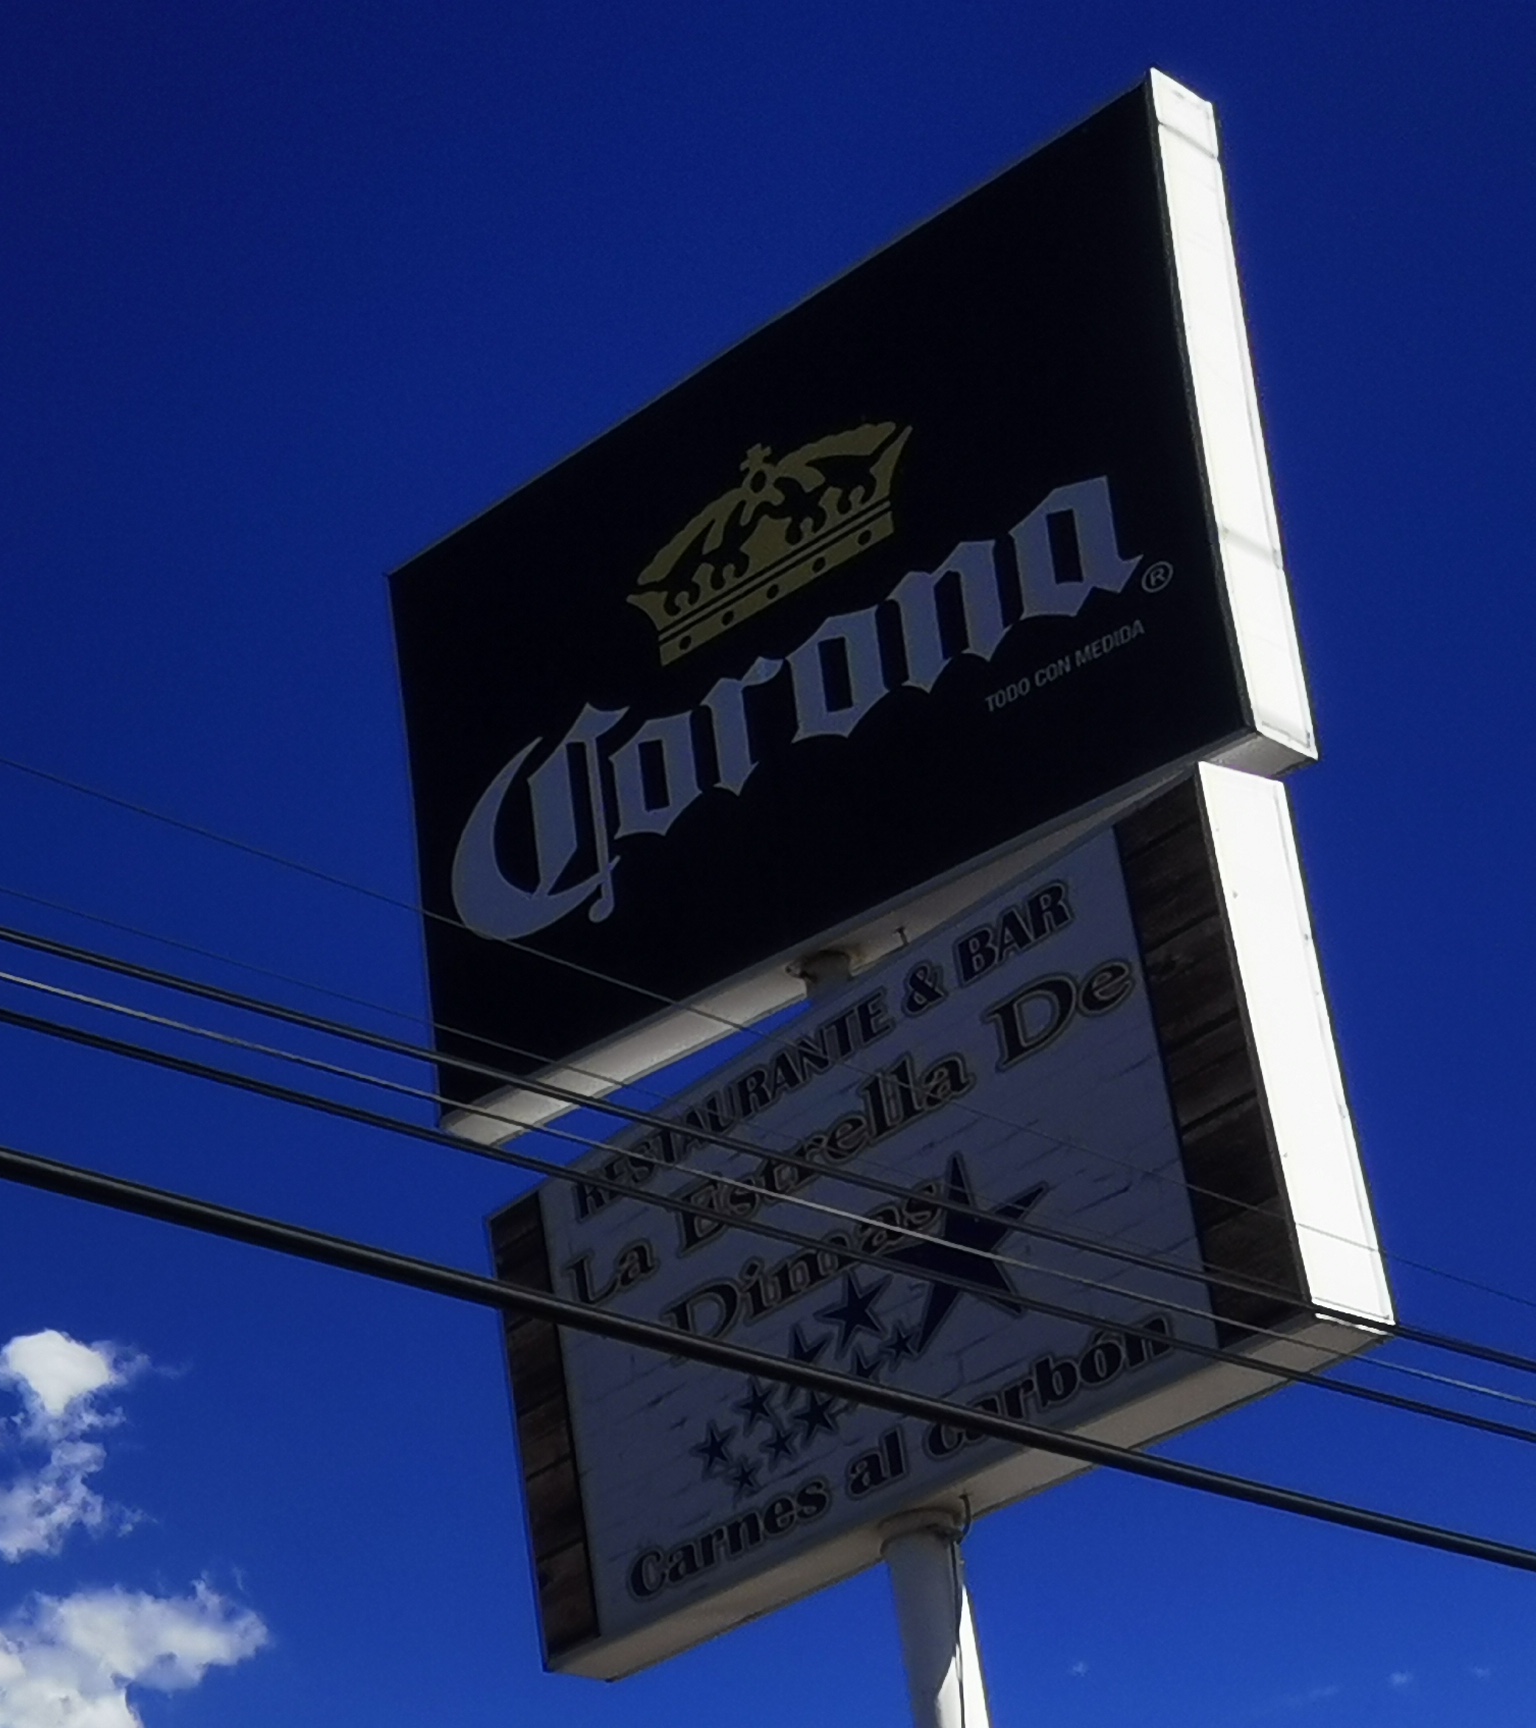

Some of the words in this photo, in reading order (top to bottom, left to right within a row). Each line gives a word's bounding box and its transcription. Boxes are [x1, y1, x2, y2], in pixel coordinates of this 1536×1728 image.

[451, 475, 1143, 942] Corona
[985, 677, 1031, 712] TODO
[1034, 655, 1072, 688] CON
[1075, 618, 1146, 668] MEDIDA
[565, 1239, 659, 1306] La
[673, 1051, 975, 1257] Estrella
[983, 959, 1134, 1071] De
[573, 988, 894, 1220] RESTAURANTE
[903, 961, 948, 1017] &
[954, 880, 1075, 988] BAR
[661, 1177, 946, 1364] Dimas
[628, 1476, 830, 1601] Carnes
[848, 1424, 907, 1499] al
